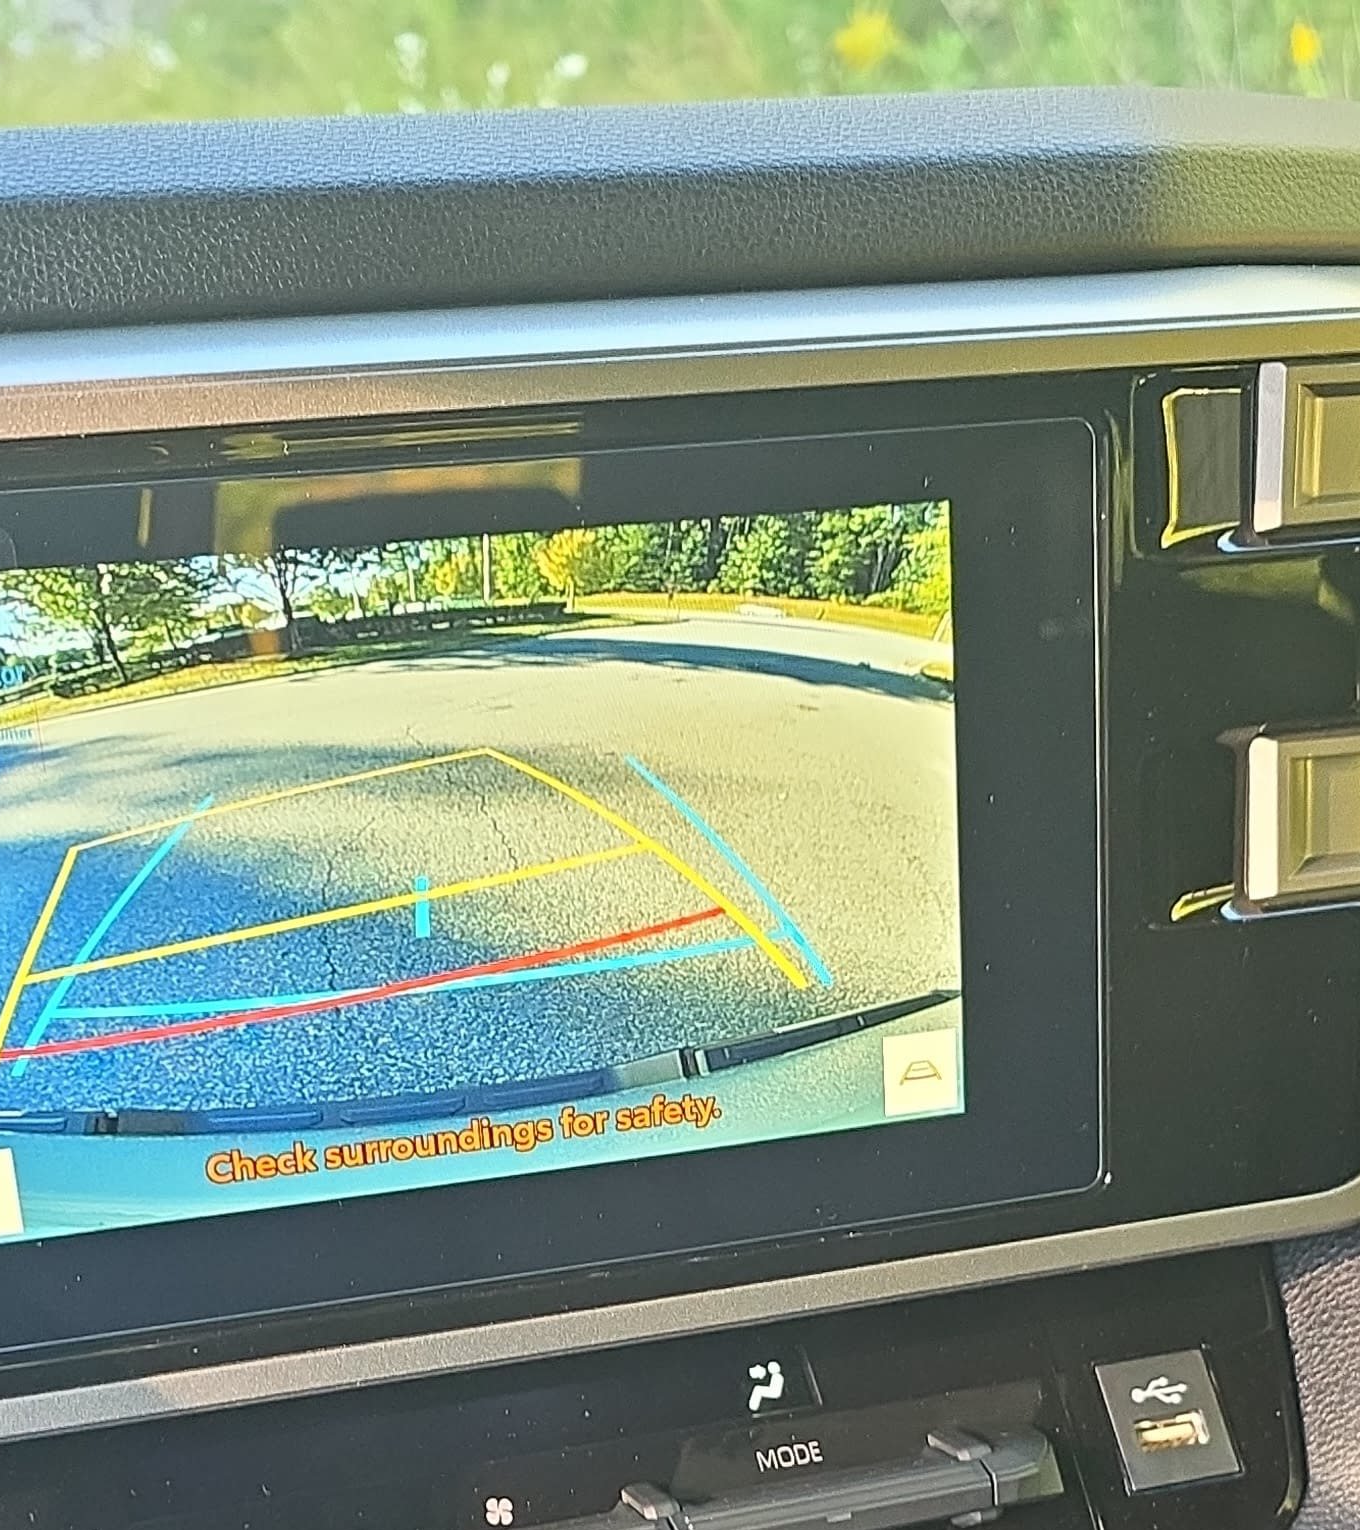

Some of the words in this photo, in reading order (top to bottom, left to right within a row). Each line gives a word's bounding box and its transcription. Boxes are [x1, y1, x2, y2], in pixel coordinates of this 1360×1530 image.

[206, 1141, 320, 1186] Check
[324, 1115, 554, 1172] surroundings
[559, 1105, 610, 1140] for
[615, 1094, 723, 1134] safety.
[755, 1440, 824, 1473] MODE
